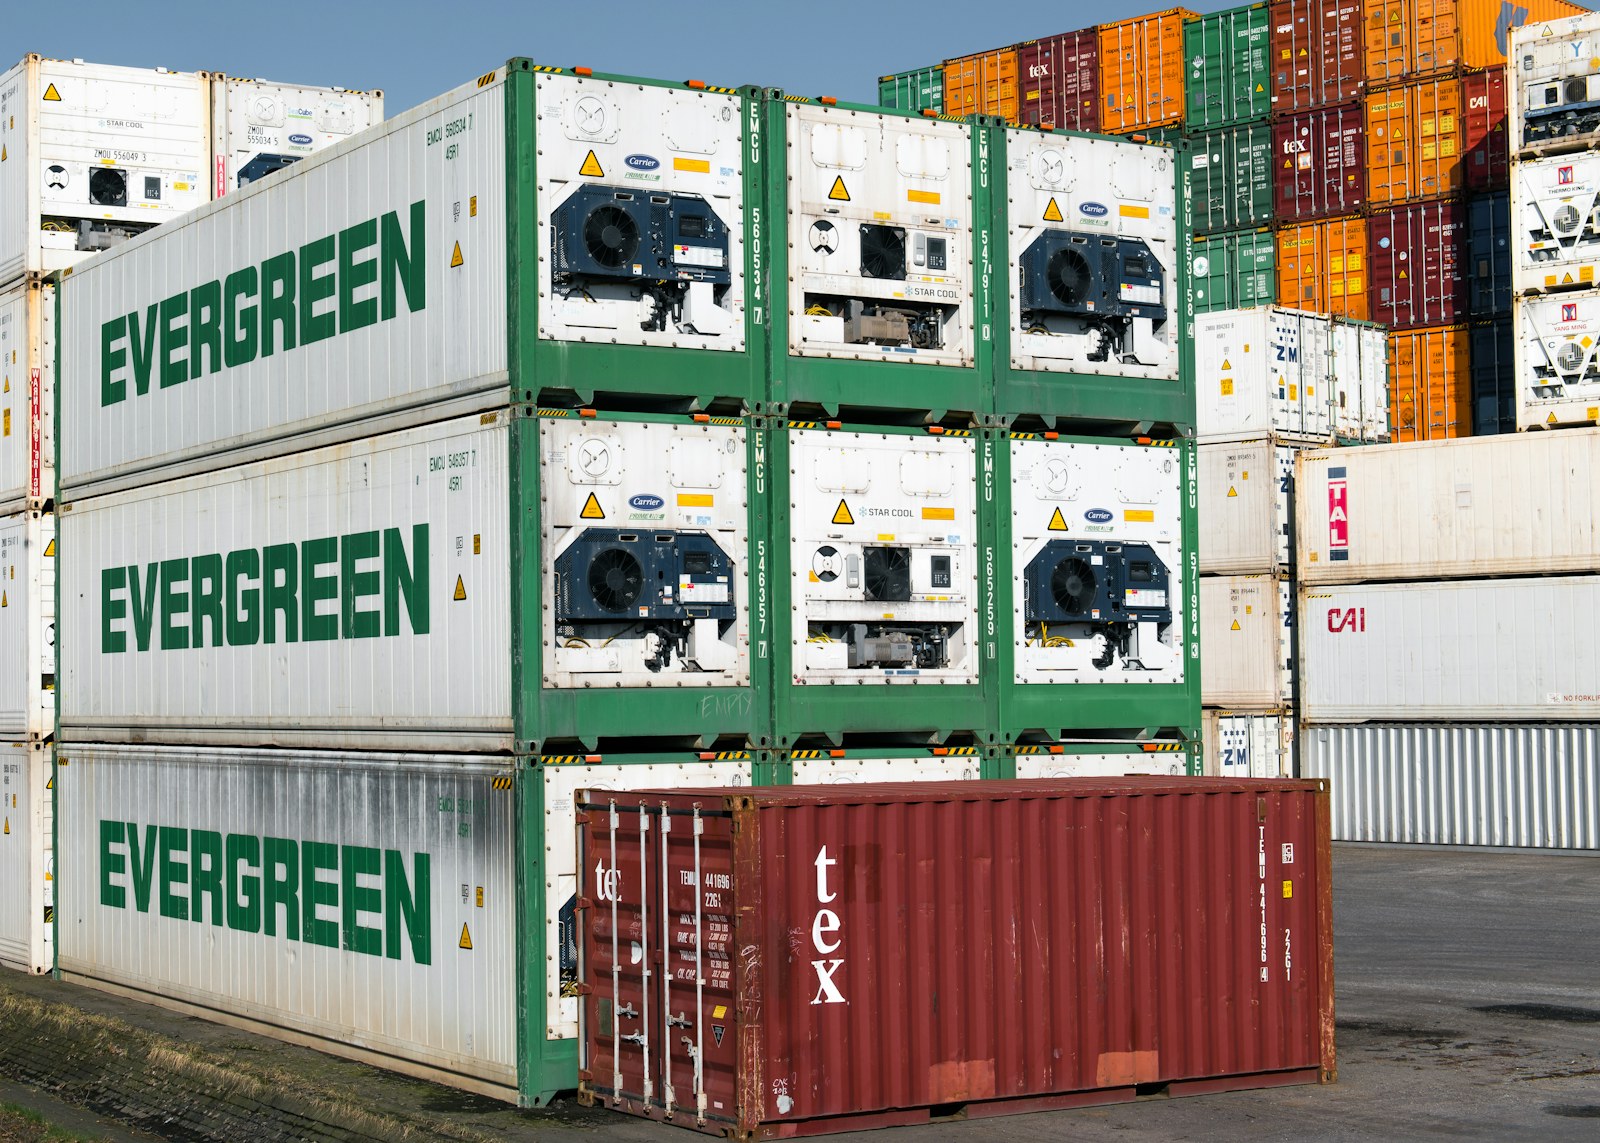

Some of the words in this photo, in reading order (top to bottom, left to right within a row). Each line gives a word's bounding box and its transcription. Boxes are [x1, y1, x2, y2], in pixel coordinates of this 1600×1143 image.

[1469, 96, 1487, 108] CAI
[248, 126, 264, 135] ZMOU
[248, 136, 271, 145] 555034
[427, 126, 443, 146] EMCU
[750, 102, 759, 163] EMCU
[94, 149, 111, 158] ZMOU
[114, 150, 139, 160] 556049
[142, 153, 147, 161] 3
[629, 157, 655, 167] Carrier
[979, 130, 988, 188] EMCU
[1183, 171, 1192, 227] EMCU
[1548, 187, 1571, 195] THERMO
[1082, 204, 1105, 213] Carrier
[753, 208, 761, 300] 560534
[981, 230, 989, 318] 547911
[1185, 233, 1194, 316] 553158
[101, 199, 426, 407] EVERGREEN
[914, 287, 935, 296] STAR
[937, 289, 959, 299] COOL
[754, 307, 762, 324] 7
[1186, 323, 1195, 338] 4
[430, 454, 446, 472] EMCU
[755, 432, 764, 494] EMCU
[984, 442, 992, 502] EMCU
[448, 476, 462, 492] 45R1
[1188, 452, 1196, 508] EMCU
[633, 497, 660, 506] Carrier
[869, 508, 889, 516] STAR
[892, 509, 914, 518] COOL
[1087, 511, 1110, 520] Carrier
[1328, 483, 1347, 545] TAL
[101, 523, 430, 654] EVERGREEN
[758, 541, 766, 634] 546357
[986, 547, 994, 636] 565259
[1190, 552, 1198, 636] 571984
[1327, 607, 1366, 633] CAI
[758, 641, 767, 658] 7
[100, 819, 432, 966] EVERGREEN
[705, 872, 730, 890] 441696
[810, 844, 846, 1005] tex
